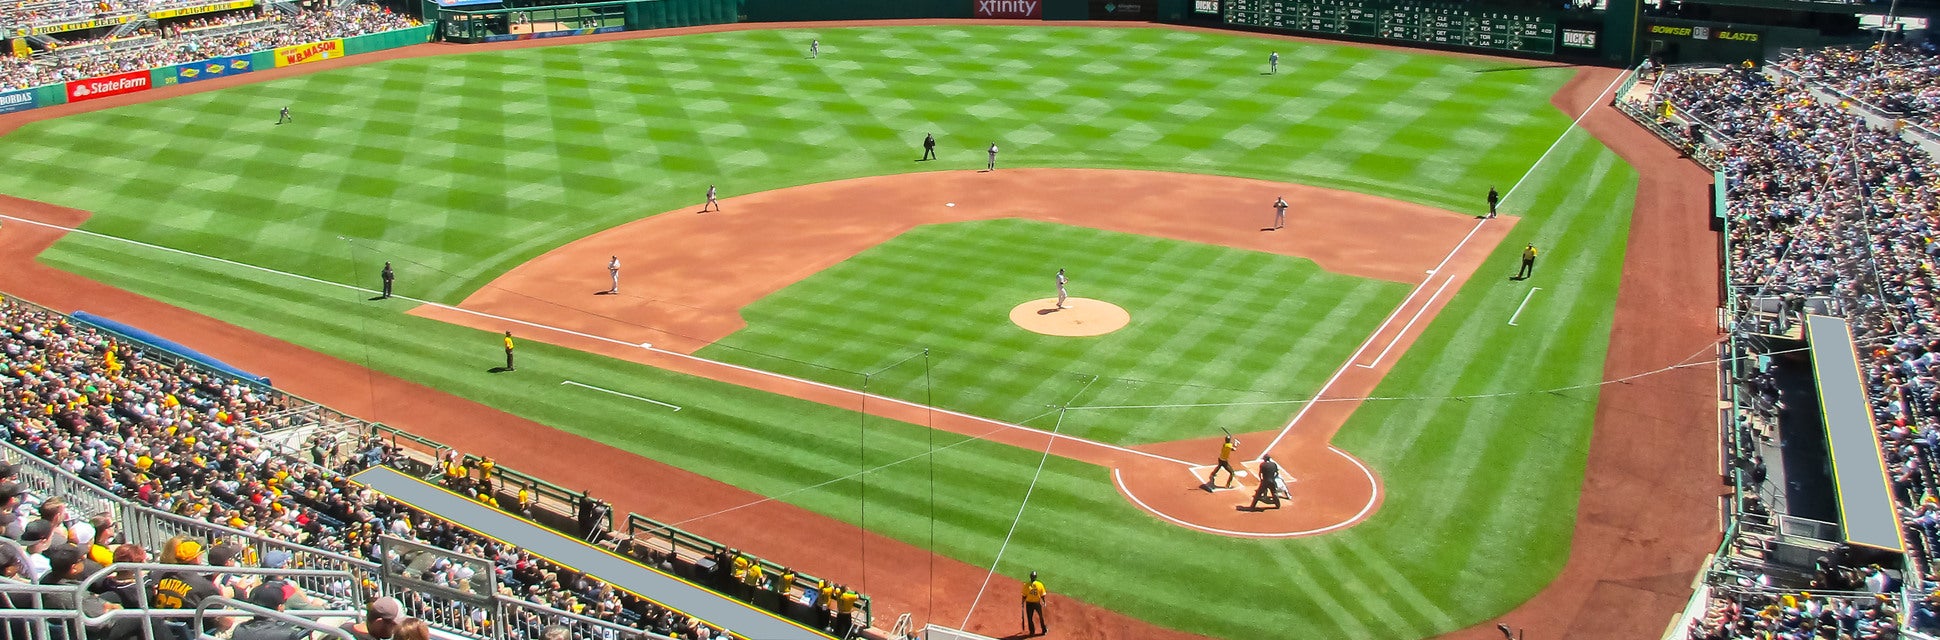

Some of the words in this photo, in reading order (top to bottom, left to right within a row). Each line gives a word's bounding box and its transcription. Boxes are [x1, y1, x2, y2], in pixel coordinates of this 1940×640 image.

[185, 5, 210, 14] LIGHT
[979, 0, 1037, 16] xfinity
[38, 25, 64, 34] IRON
[68, 22, 90, 30] CITY
[94, 17, 120, 26] BEER
[1651, 25, 1691, 36] BOWSER
[1564, 32, 1595, 45] DICK'S
[1719, 31, 1759, 42] BLASTS
[0, 92, 32, 106] BORDAS
